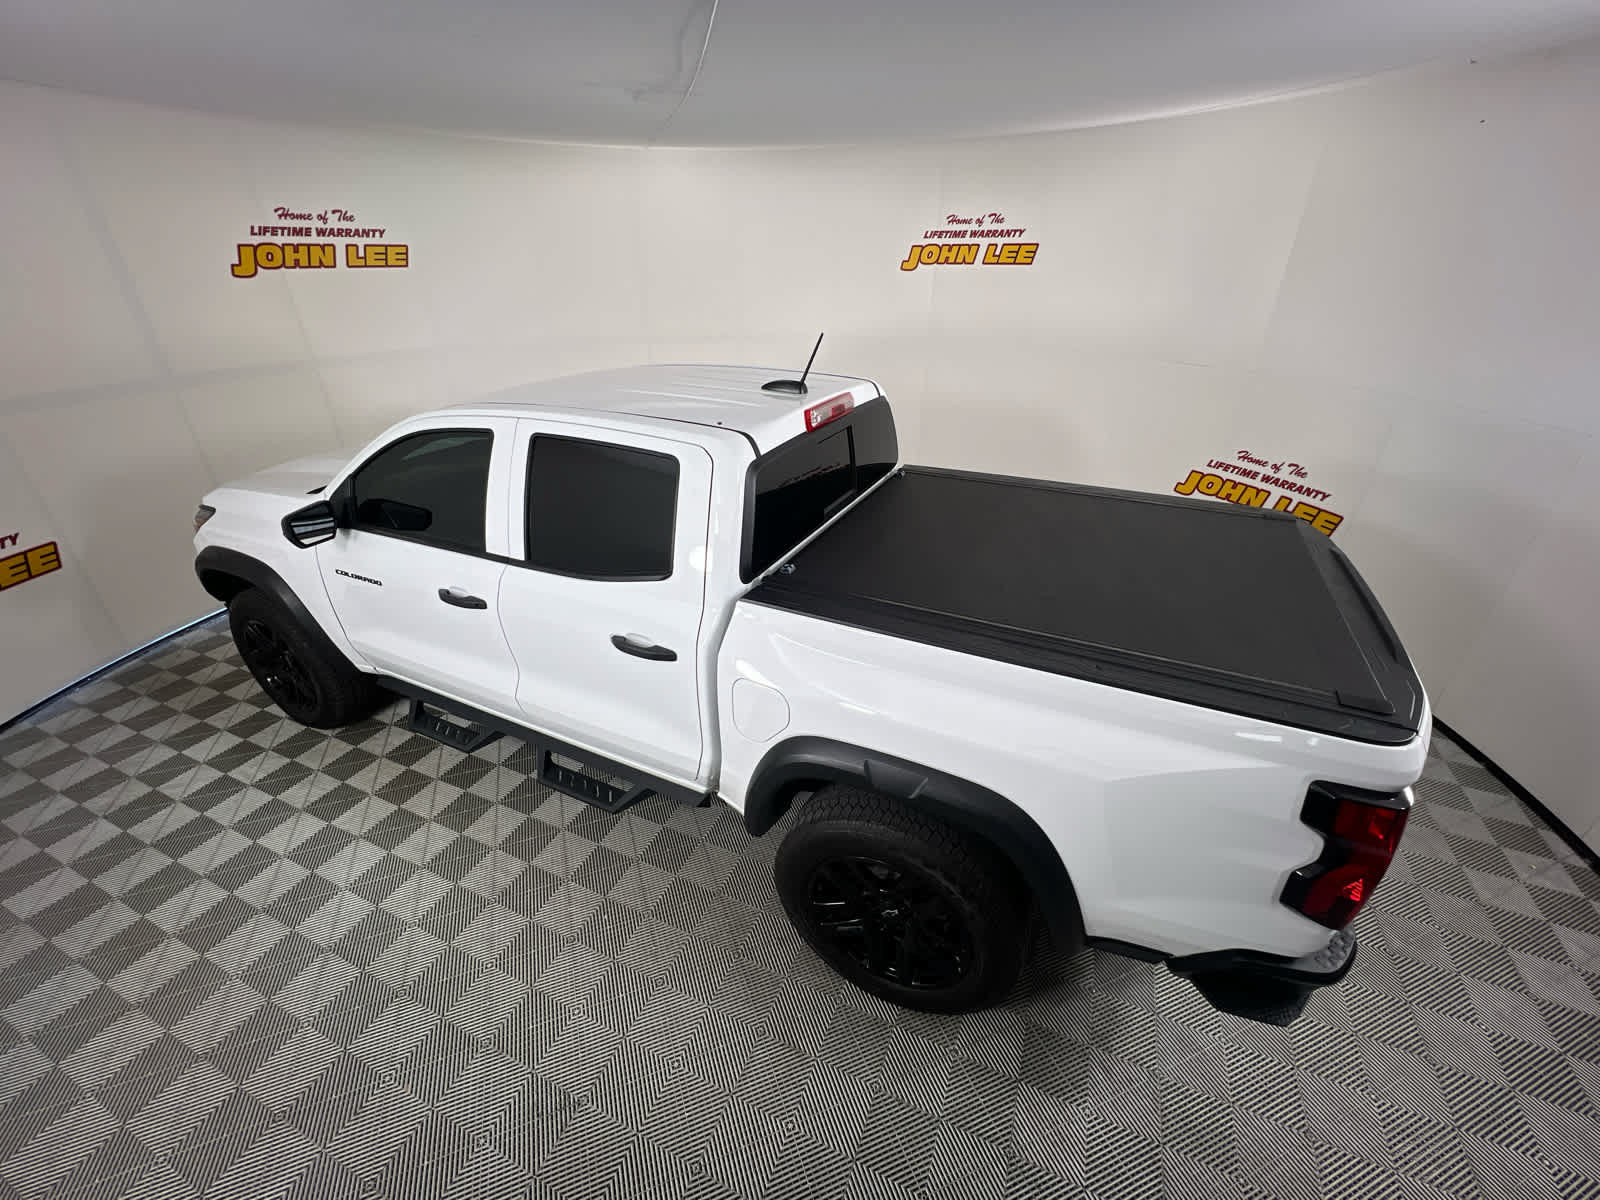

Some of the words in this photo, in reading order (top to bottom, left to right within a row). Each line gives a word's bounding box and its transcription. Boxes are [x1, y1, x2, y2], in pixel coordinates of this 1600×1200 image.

[274, 207, 313, 220] Home
[317, 210, 328, 224] of
[332, 209, 355, 222] The
[946, 214, 973, 225] Home
[975, 214, 986, 227] of
[988, 212, 1005, 224] The
[250, 226, 312, 237] LIFETIME
[315, 227, 386, 238] WARRANTY
[923, 230, 967, 239] LIFETIME
[969, 228, 1026, 238] WARRANTY
[231, 242, 336, 278] JOHN
[345, 243, 409, 268] LEE
[900, 243, 980, 271] JOHN
[982, 243, 1039, 265] LEE
[1237, 450, 1269, 468] Home
[1270, 461, 1285, 474] of
[1287, 462, 1308, 479] The
[1206, 459, 1261, 480] LIFETIME
[1260, 473, 1332, 502] WARRANTY
[1174, 469, 1271, 508] JOHN
[1273, 495, 1344, 538] LEE
[335, 568, 383, 586] COLORADO
